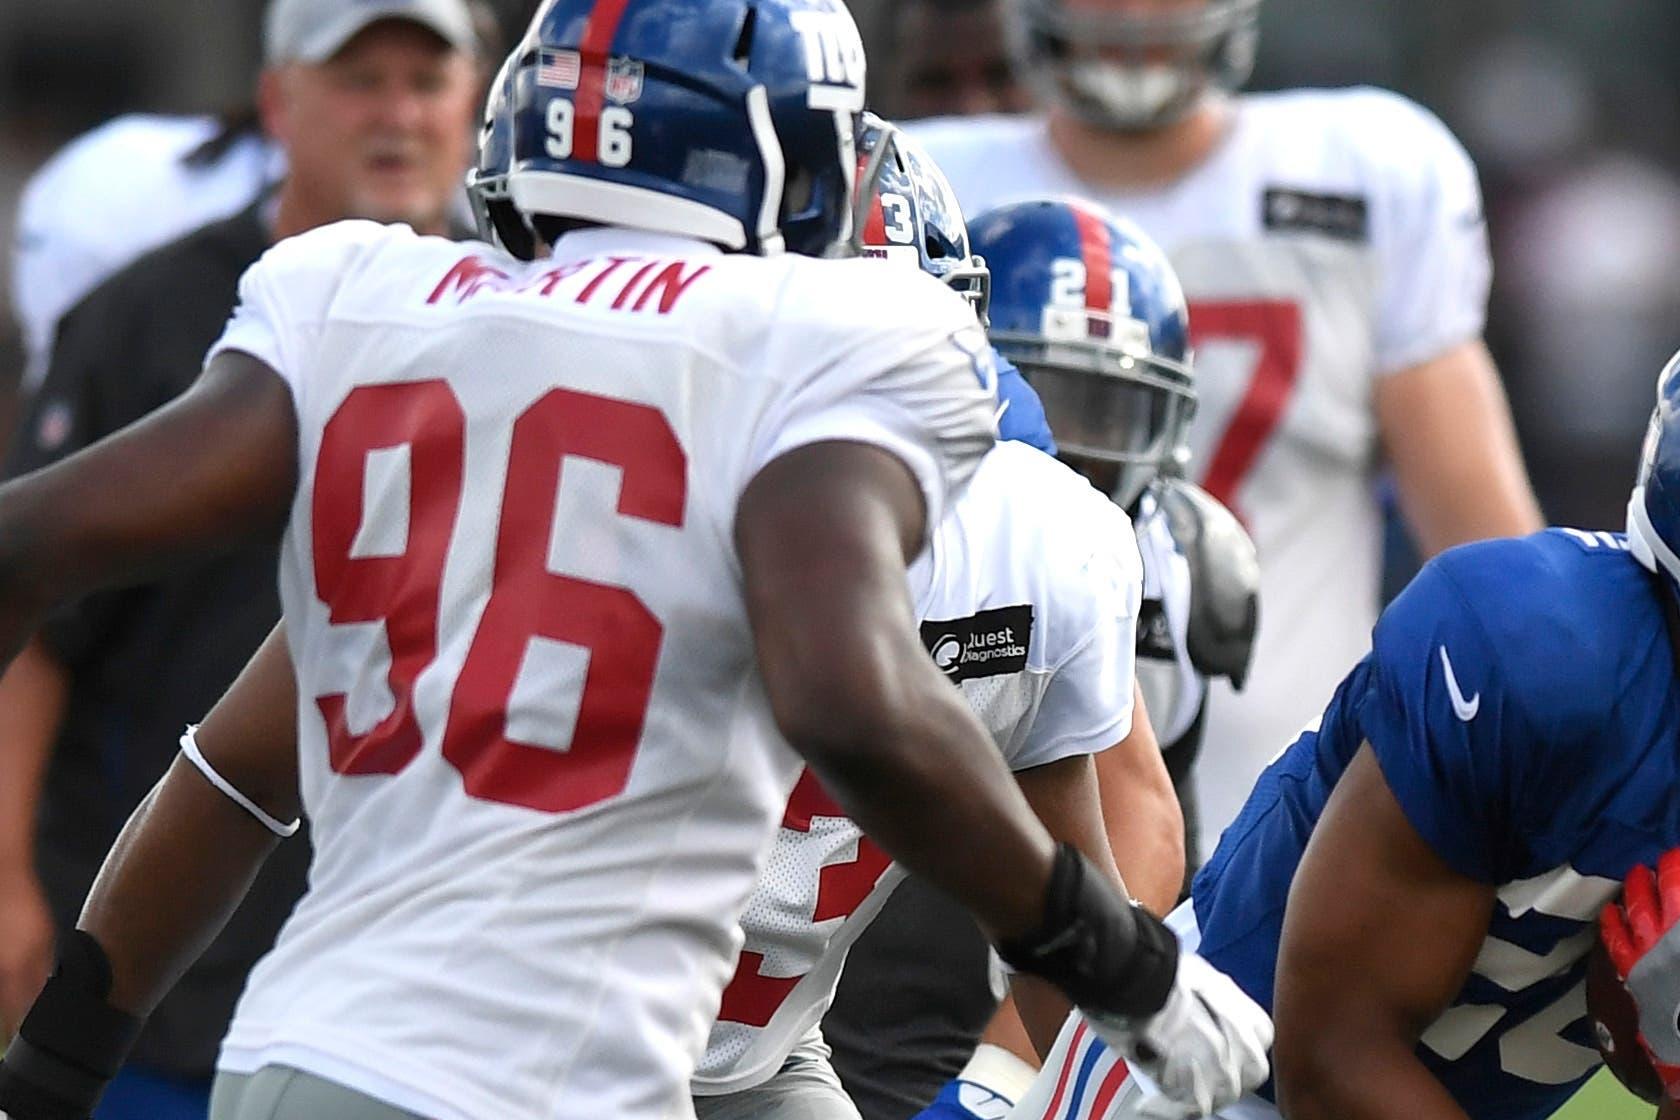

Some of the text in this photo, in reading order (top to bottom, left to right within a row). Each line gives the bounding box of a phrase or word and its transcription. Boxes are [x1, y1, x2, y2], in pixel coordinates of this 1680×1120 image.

[545, 97, 634, 168] 96
[425, 255, 711, 314] MRTIN
[1050, 258, 1130, 315] 21
[312, 378, 688, 814] 96
